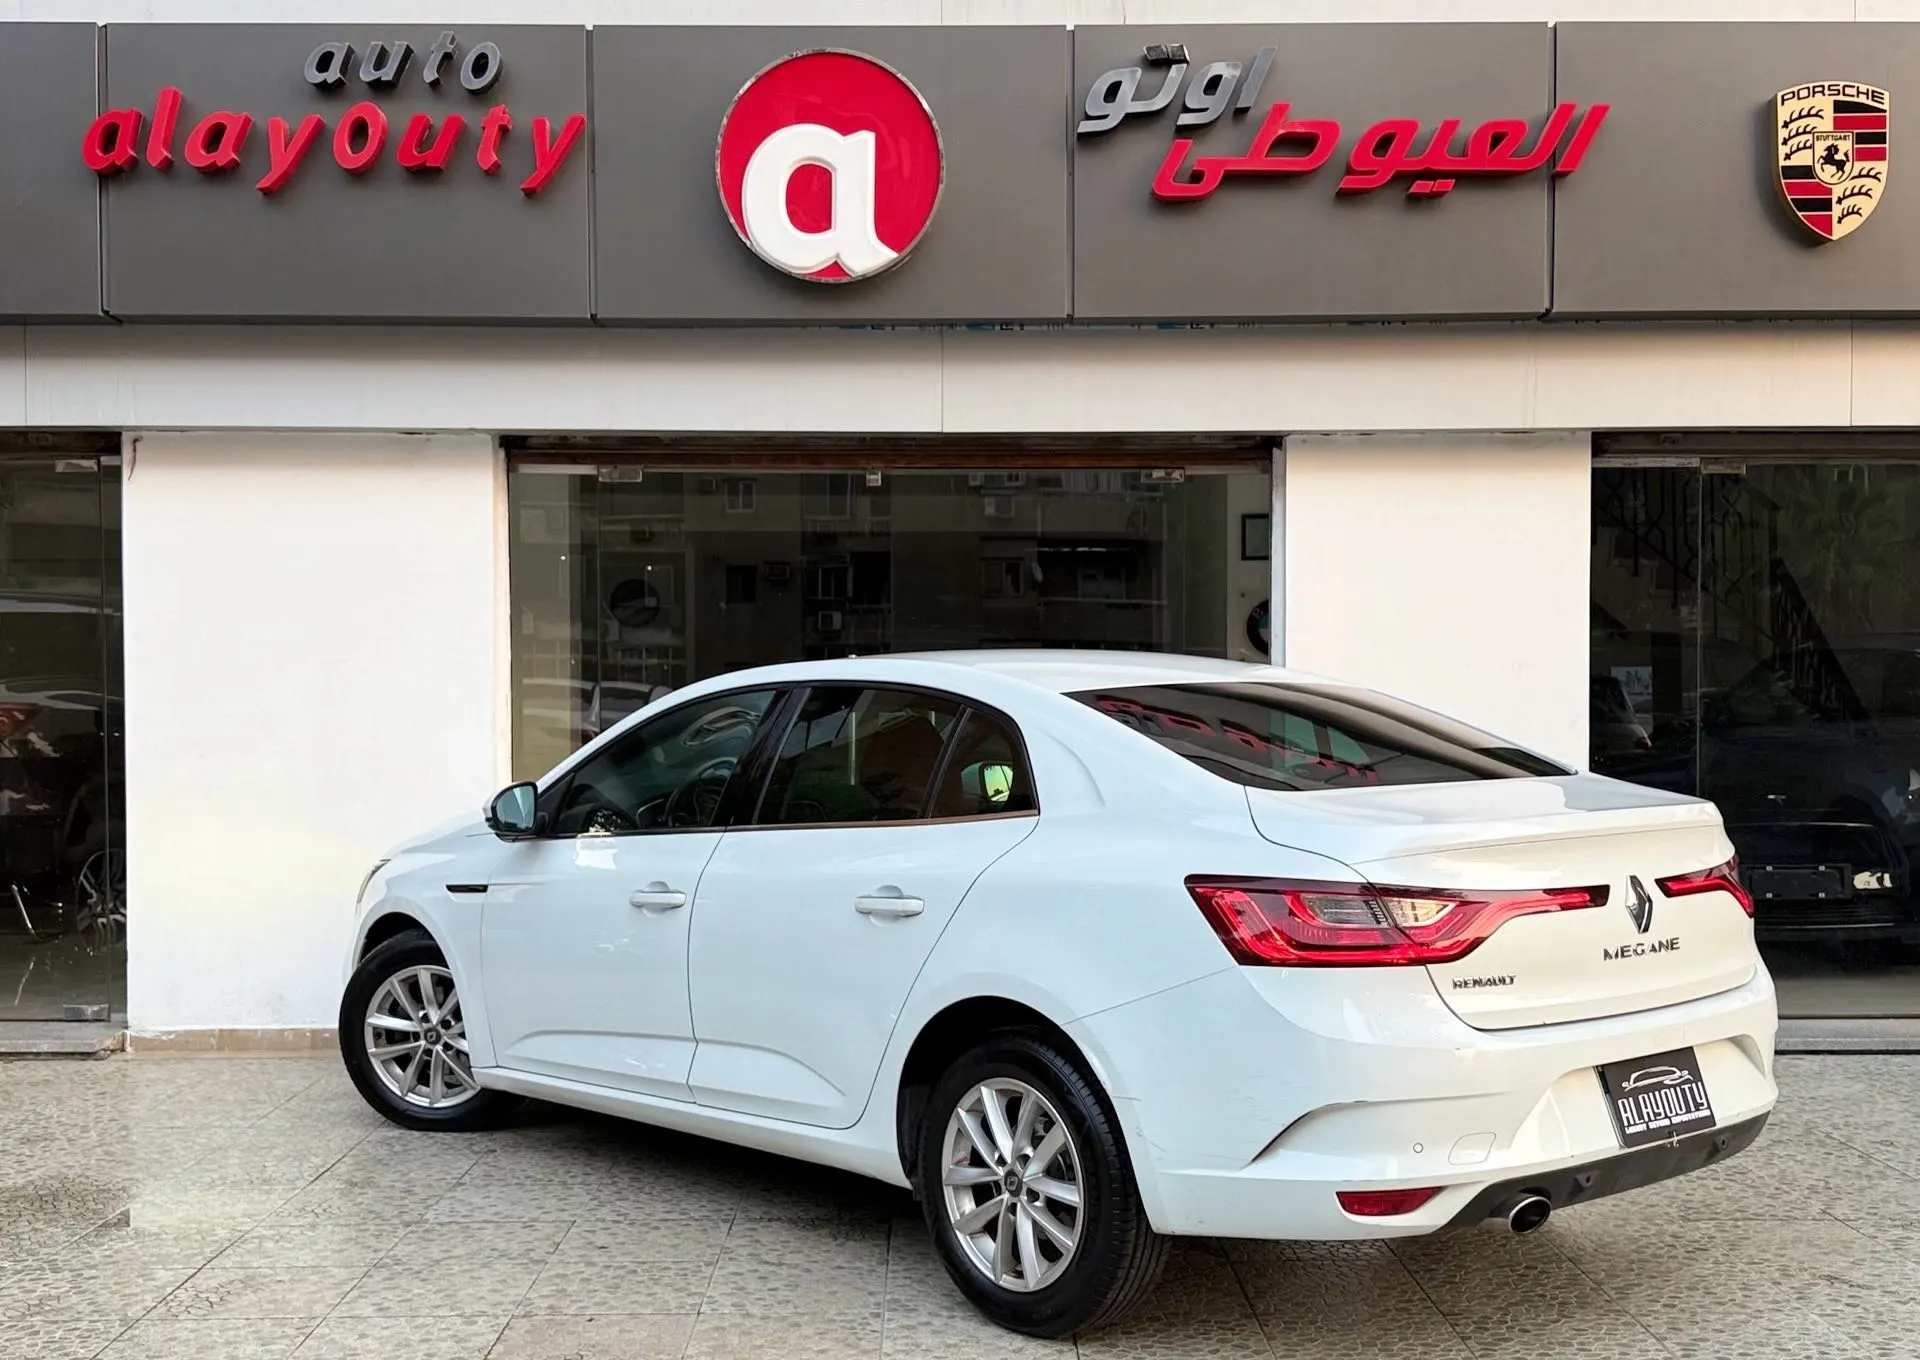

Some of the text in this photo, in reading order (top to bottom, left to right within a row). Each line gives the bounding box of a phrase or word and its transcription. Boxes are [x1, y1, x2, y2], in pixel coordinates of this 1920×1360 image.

[304, 31, 501, 95] auto
[1076, 43, 1278, 139] اوتو
[1781, 84, 1884, 106] PORSCHE
[82, 86, 586, 197] alayouty
[1815, 134, 1852, 142] STUTTGART
[741, 123, 900, 278] a
[1603, 937, 1681, 962] MEGANE
[1452, 974, 1517, 990] RENAULT
[1618, 1081, 1709, 1127] ALAYOUTY
